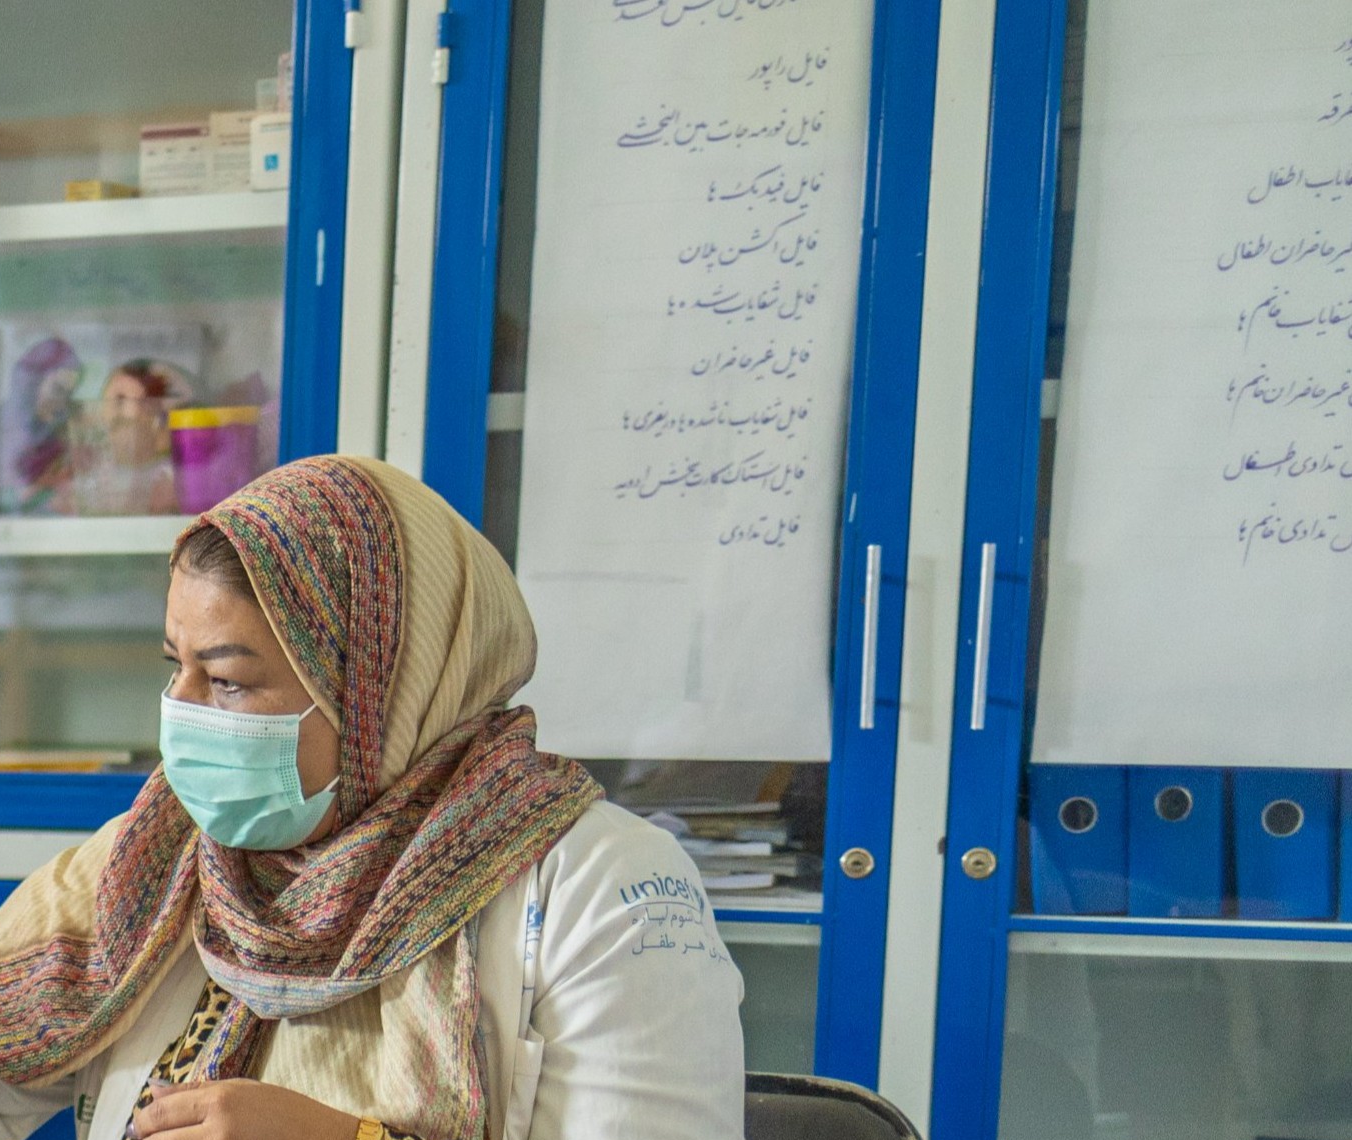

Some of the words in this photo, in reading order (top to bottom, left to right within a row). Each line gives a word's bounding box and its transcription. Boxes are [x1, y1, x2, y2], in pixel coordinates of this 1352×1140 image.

[619, 872, 694, 905] unicef
[632, 933, 676, 955] طفل
[683, 941, 705, 955] هر
